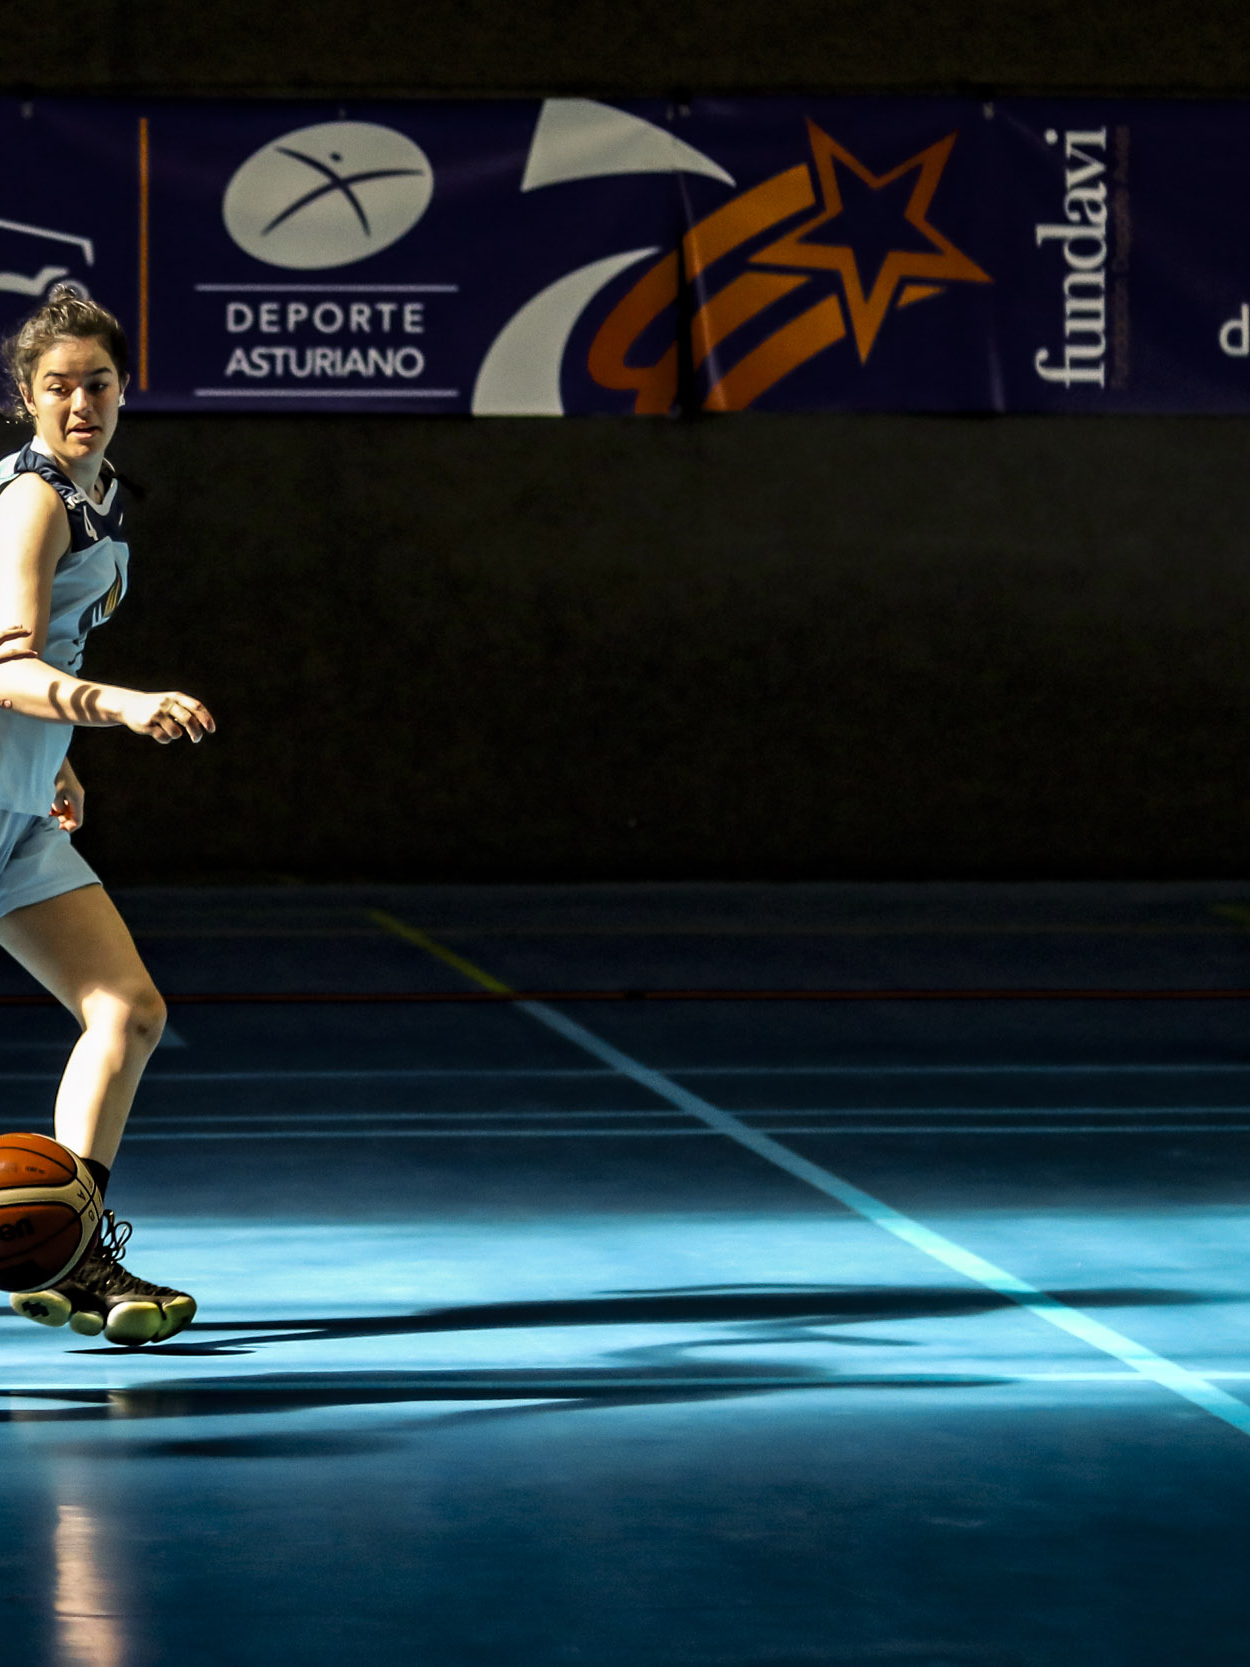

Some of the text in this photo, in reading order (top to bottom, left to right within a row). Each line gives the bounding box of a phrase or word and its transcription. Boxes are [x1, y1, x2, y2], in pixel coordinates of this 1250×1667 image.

[1034, 127, 1108, 389] fundavi
[226, 302, 425, 334] DEPORTE
[225, 346, 425, 379] ASTURIANO
